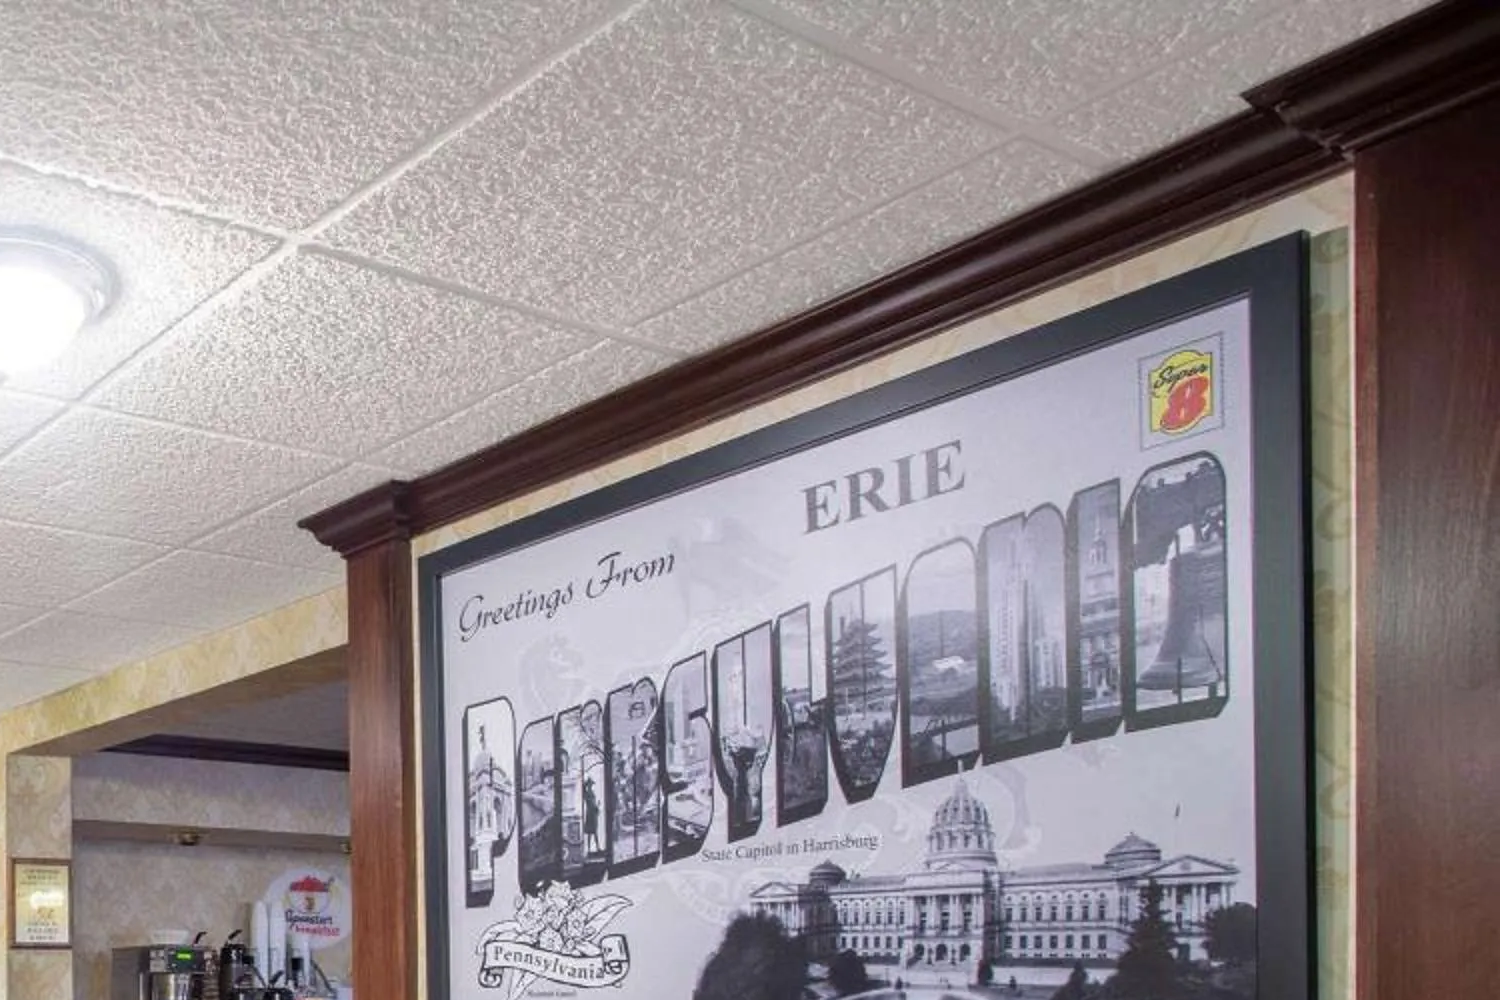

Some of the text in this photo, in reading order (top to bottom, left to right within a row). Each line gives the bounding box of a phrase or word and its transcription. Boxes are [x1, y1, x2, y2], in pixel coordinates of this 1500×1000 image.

[1151, 362, 1208, 398] Super
[1159, 375, 1210, 432] 8
[800, 439, 965, 535] ERIE
[459, 551, 675, 642] Greetings From
[702, 834, 880, 862] State Capitol in Harrisburg
[493, 946, 605, 980] Pennsylvania
